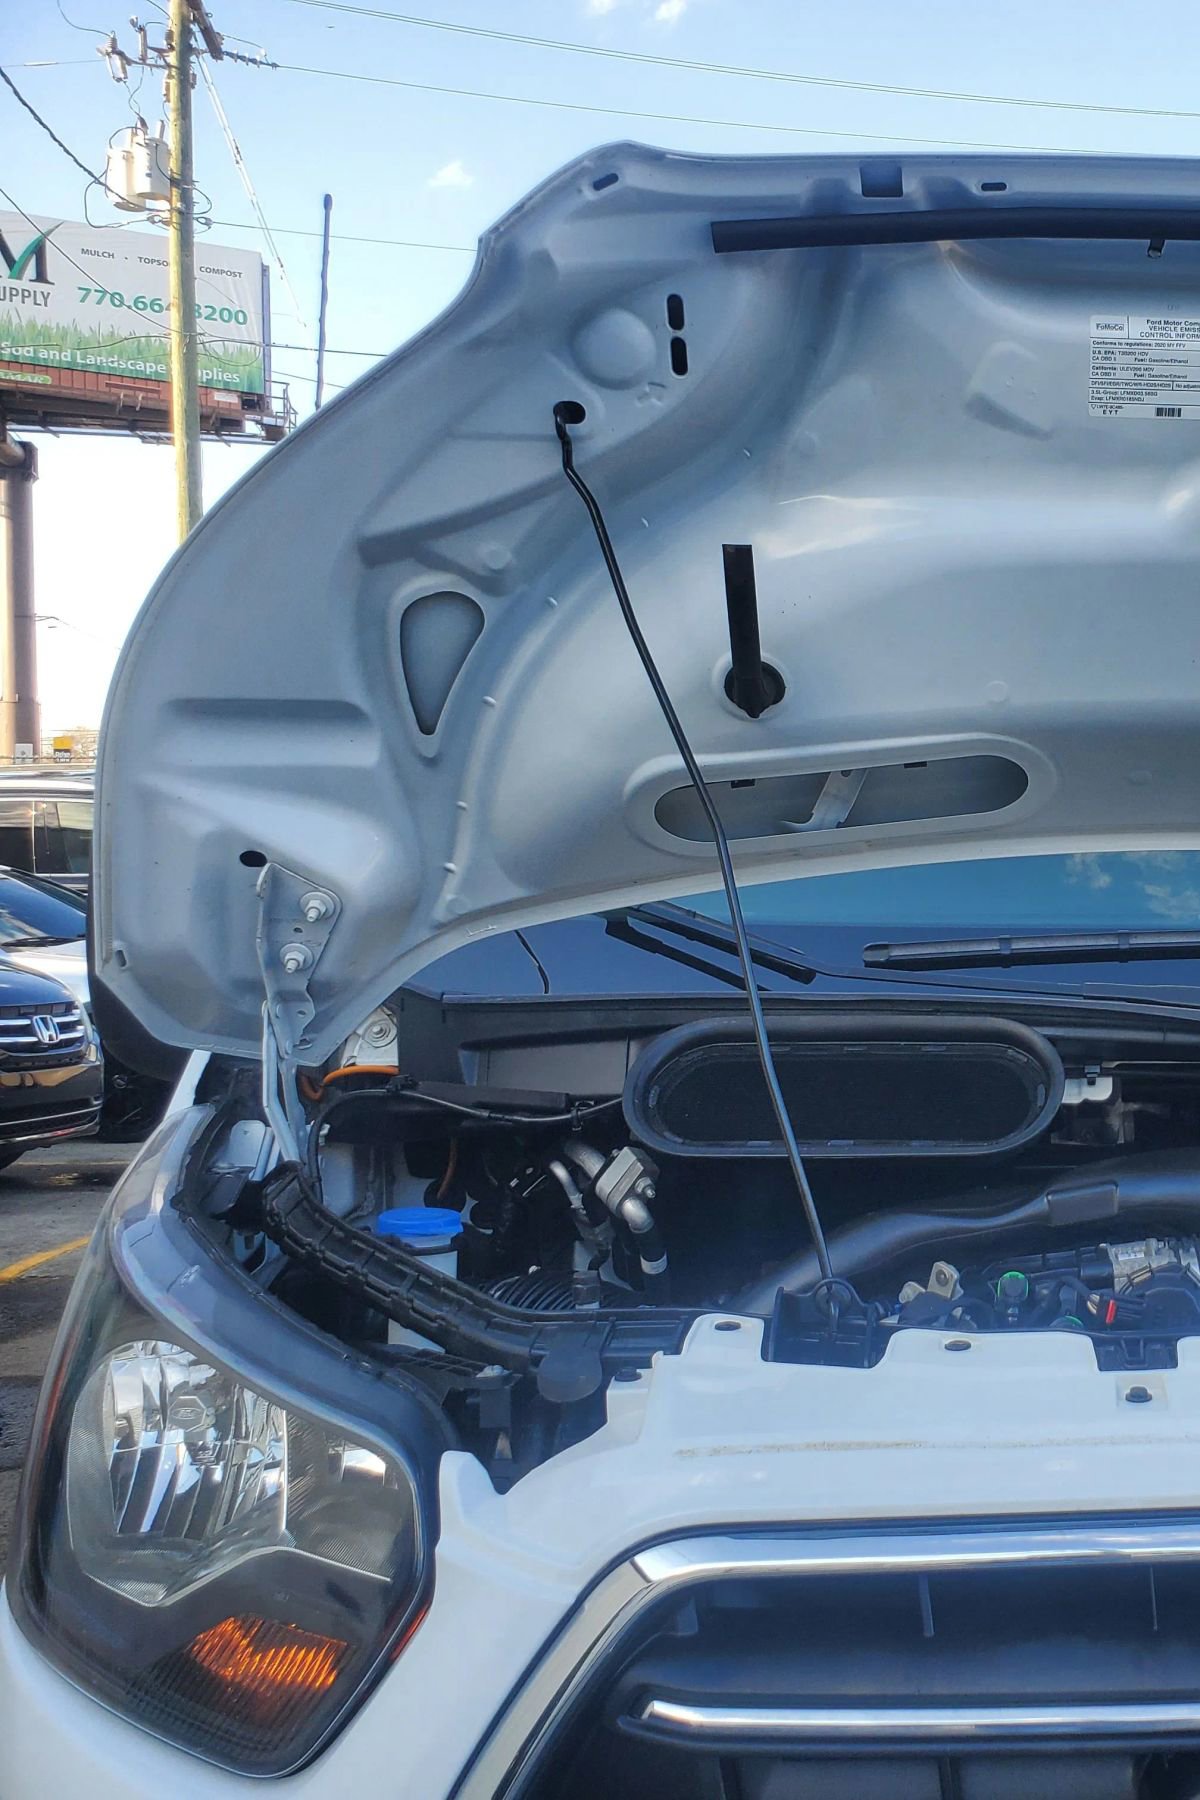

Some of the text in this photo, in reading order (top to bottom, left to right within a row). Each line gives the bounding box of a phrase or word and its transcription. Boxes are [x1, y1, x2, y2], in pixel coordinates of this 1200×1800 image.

[81, 248, 243, 279] MULCH TOPSO COMPOST
[1096, 323, 1124, 331] FoMoCo
[0, 342, 34, 357] Sod
[39, 348, 72, 361] and
[77, 350, 167, 375] Landscape
